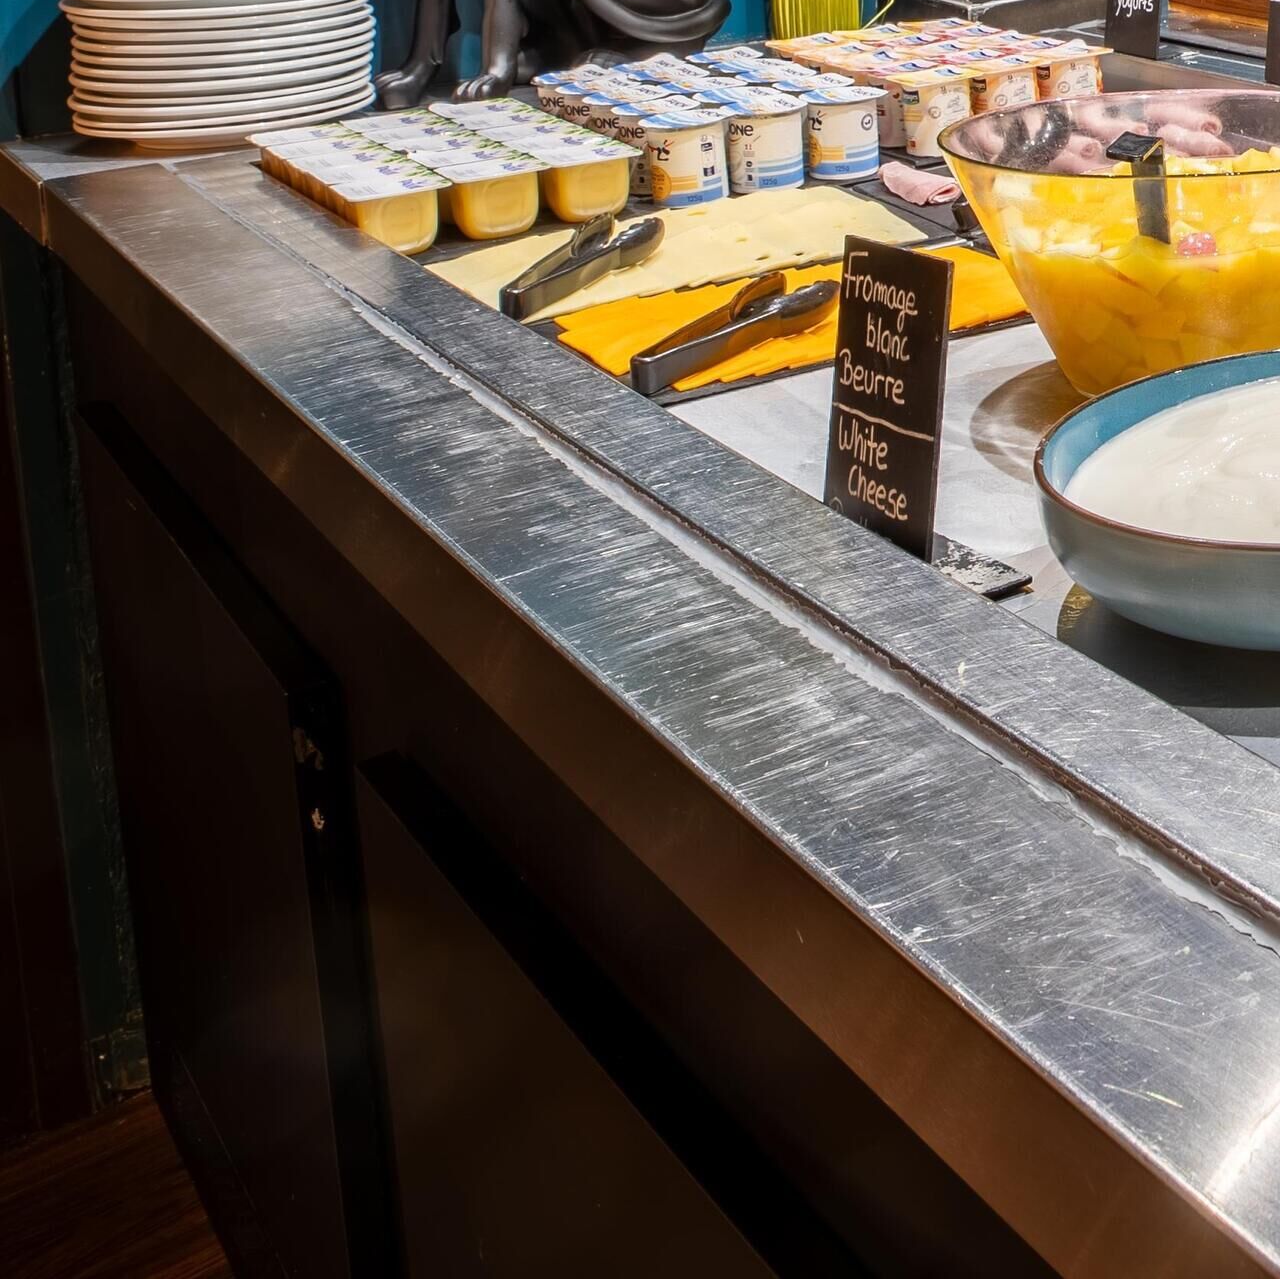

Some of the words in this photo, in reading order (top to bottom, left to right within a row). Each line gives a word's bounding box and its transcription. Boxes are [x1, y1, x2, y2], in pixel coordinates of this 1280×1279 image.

[762, 178, 777, 187] 125g
[844, 251, 918, 332] Fromage
[866, 312, 910, 361] blanc
[839, 348, 905, 405] Beurre
[838, 414, 888, 470] White
[848, 464, 908, 521] Cheese
